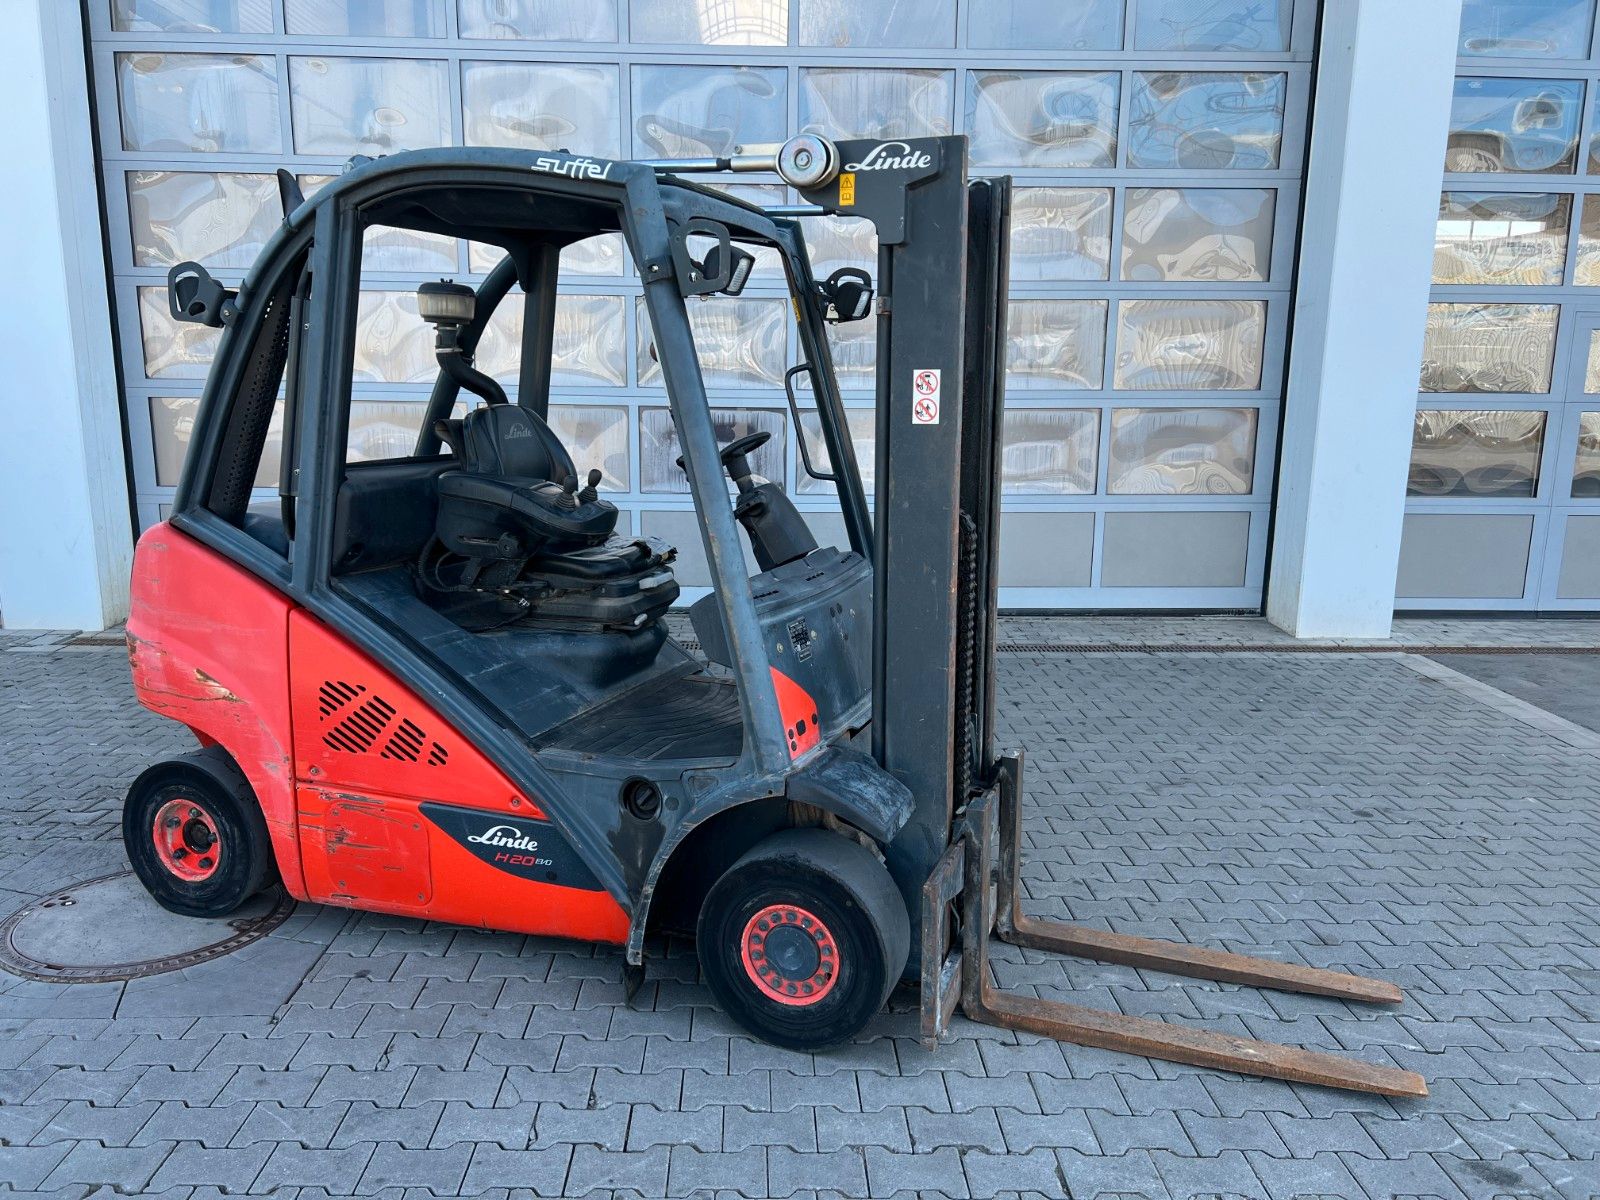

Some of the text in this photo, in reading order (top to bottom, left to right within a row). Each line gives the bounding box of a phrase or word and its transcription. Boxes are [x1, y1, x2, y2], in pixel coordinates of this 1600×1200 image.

[531, 157, 613, 180] suffel
[844, 142, 931, 172] Linde
[504, 422, 532, 440] Linde
[467, 825, 538, 852] Linde
